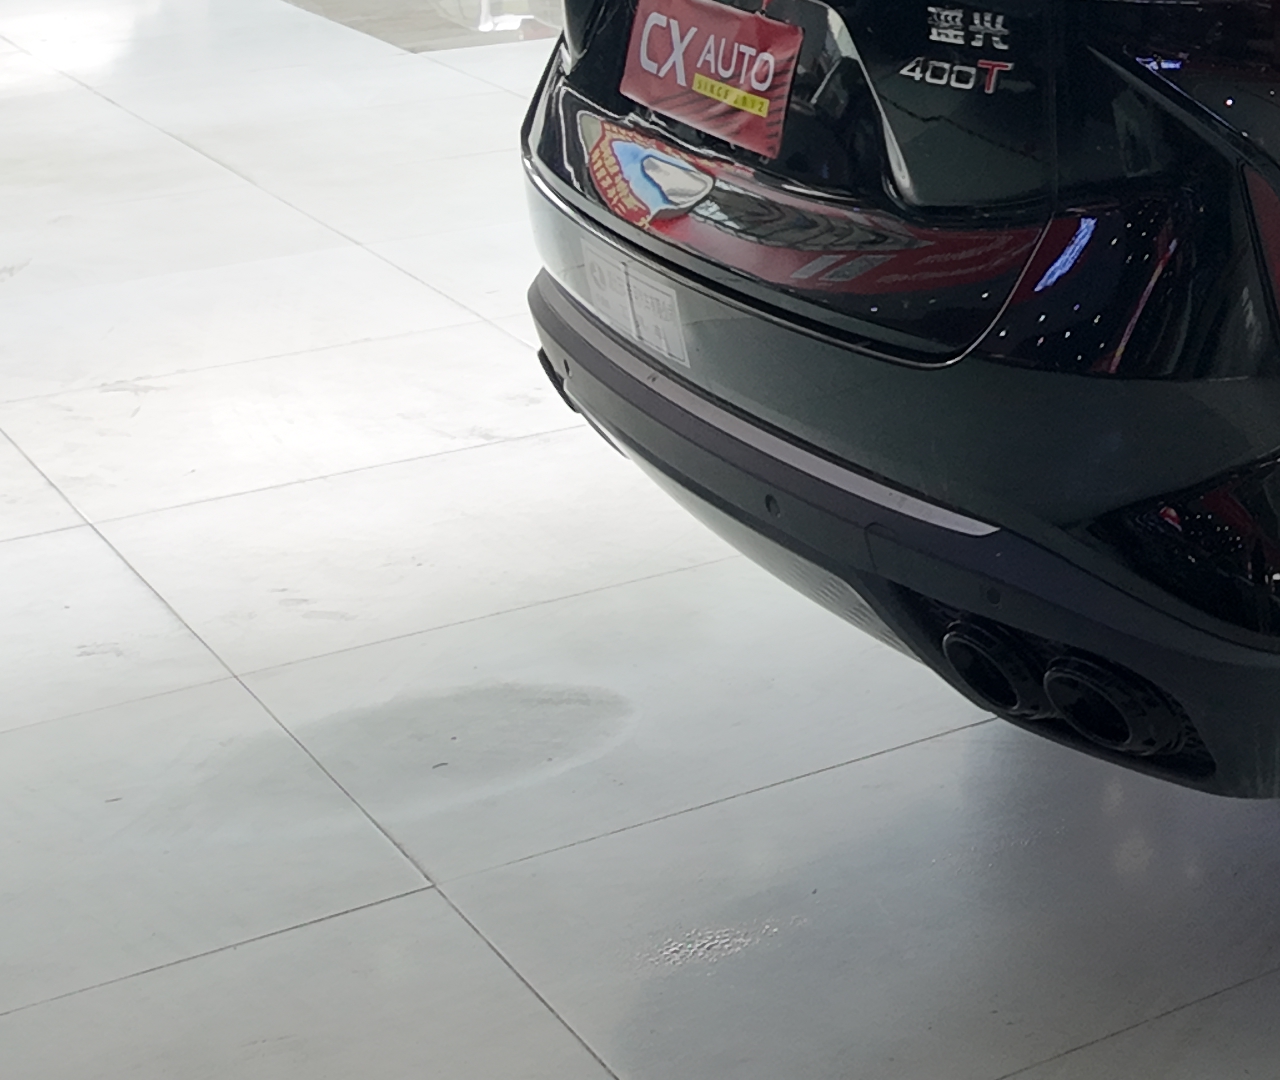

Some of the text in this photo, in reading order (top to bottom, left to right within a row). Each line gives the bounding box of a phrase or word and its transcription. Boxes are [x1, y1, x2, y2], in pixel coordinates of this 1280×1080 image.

[640, 11, 776, 92] CX AUTO
[899, 56, 1015, 94] 400T
